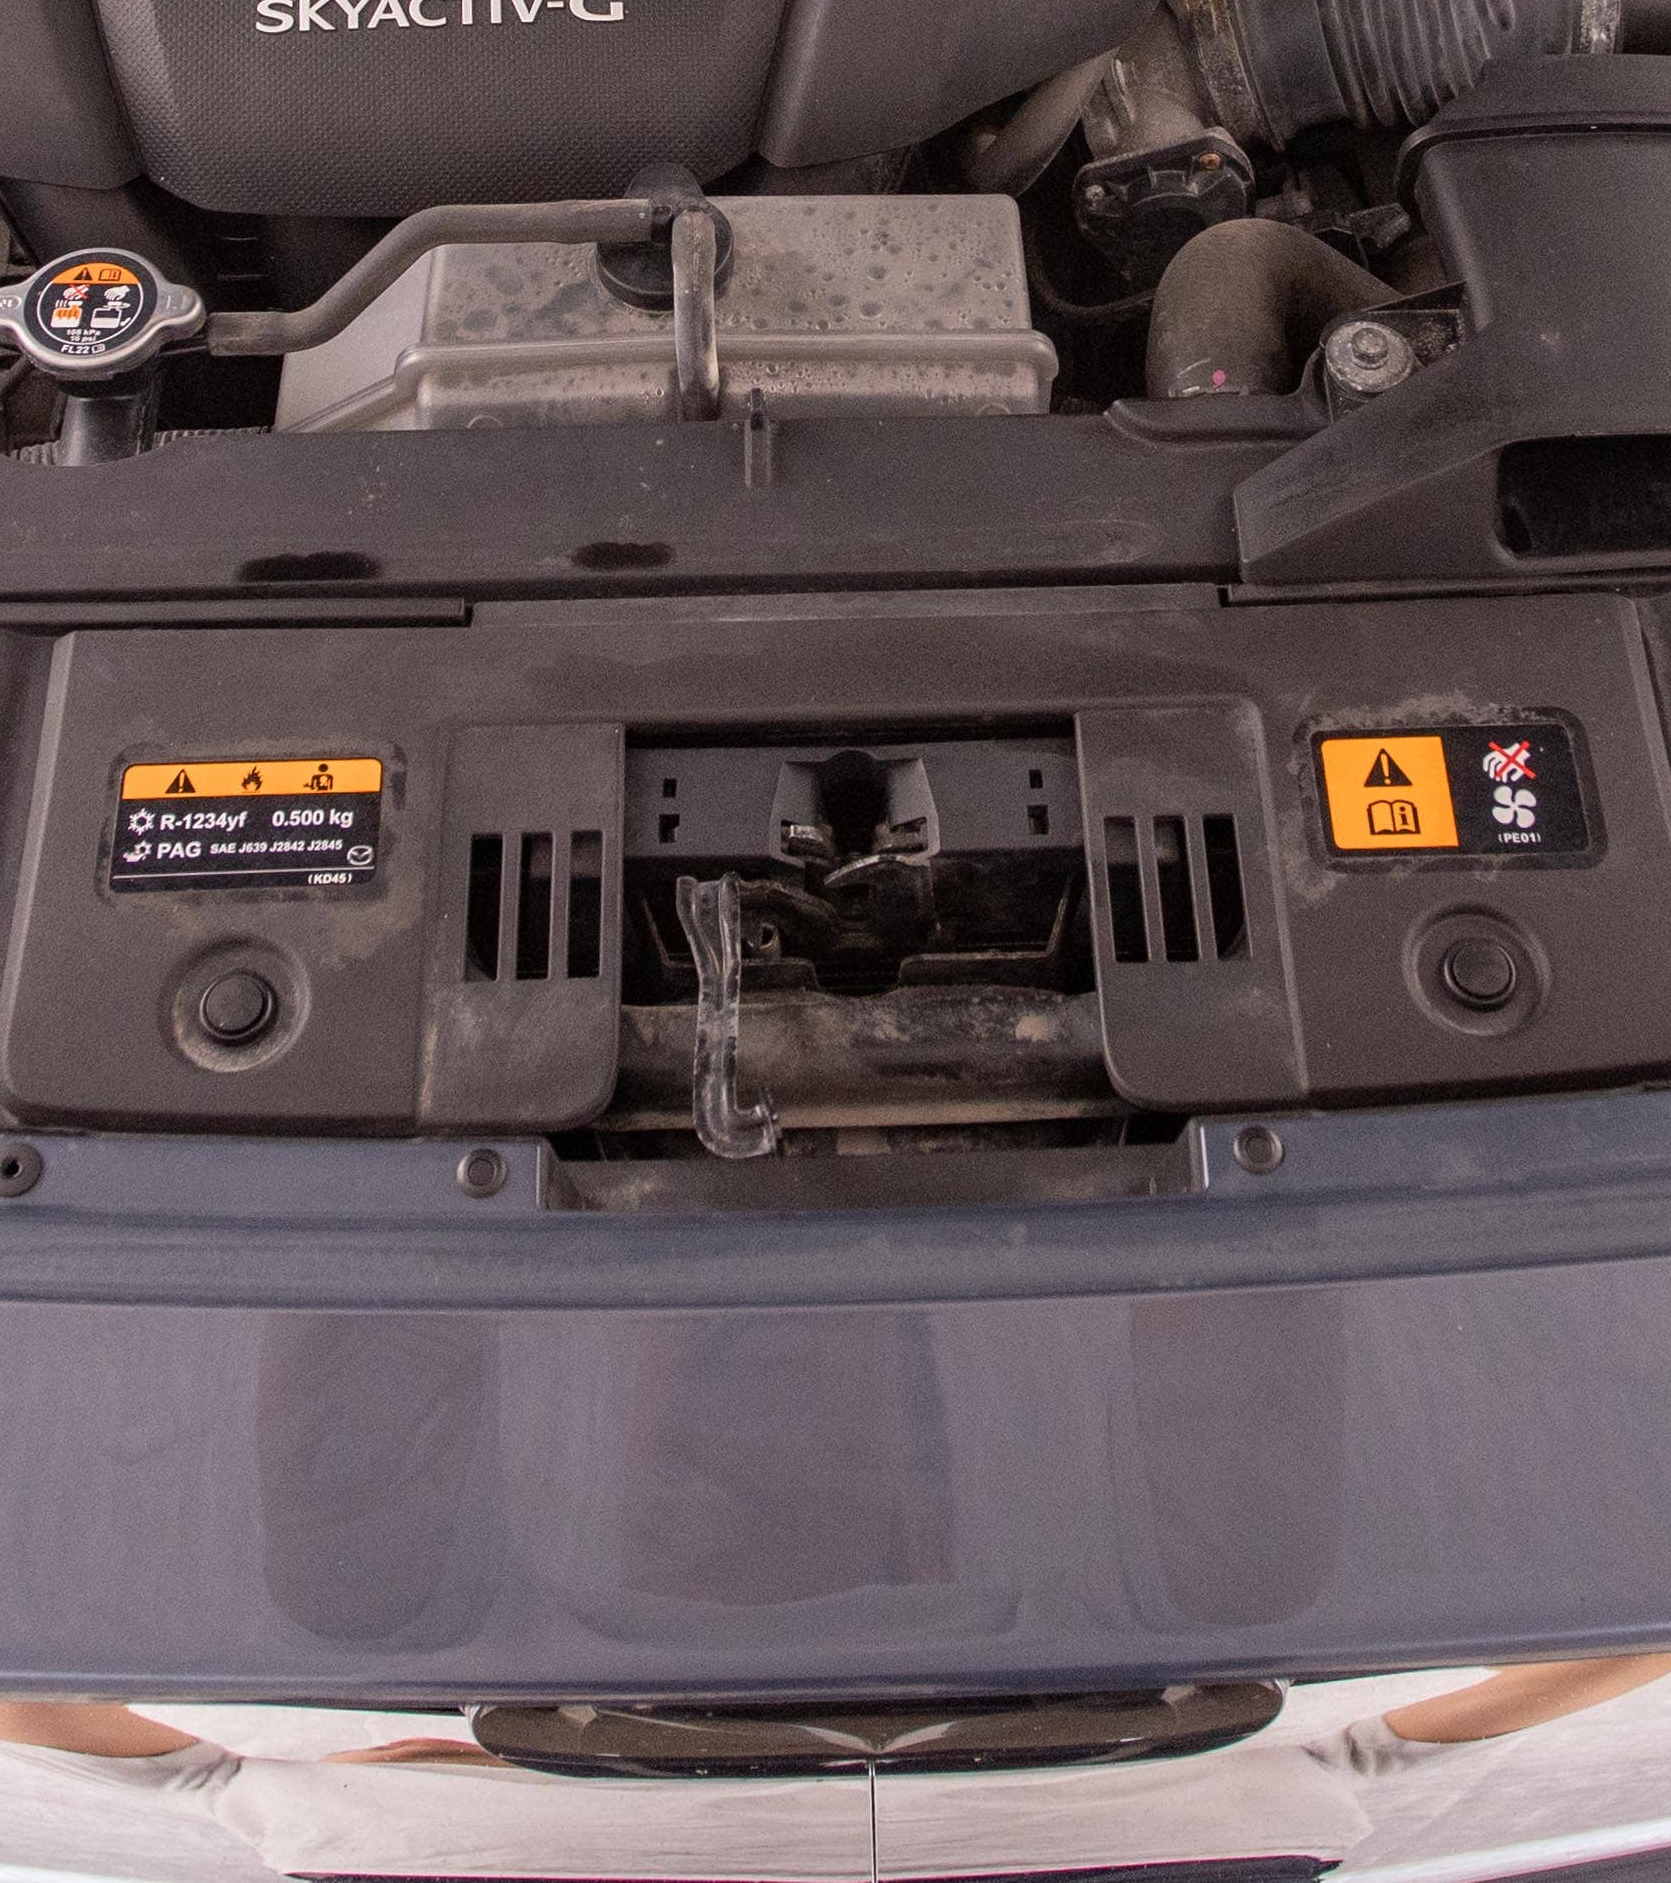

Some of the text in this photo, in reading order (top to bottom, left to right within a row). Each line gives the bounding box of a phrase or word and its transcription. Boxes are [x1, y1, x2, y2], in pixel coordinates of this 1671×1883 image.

[61, 344, 90, 354] FL22
[159, 808, 355, 833] R-1234yf 0.500 kg
[1497, 831, 1542, 844] (PE01)
[157, 839, 344, 860] PAG SAE J639 J2842 J2845
[307, 871, 353, 886] (KD45)
